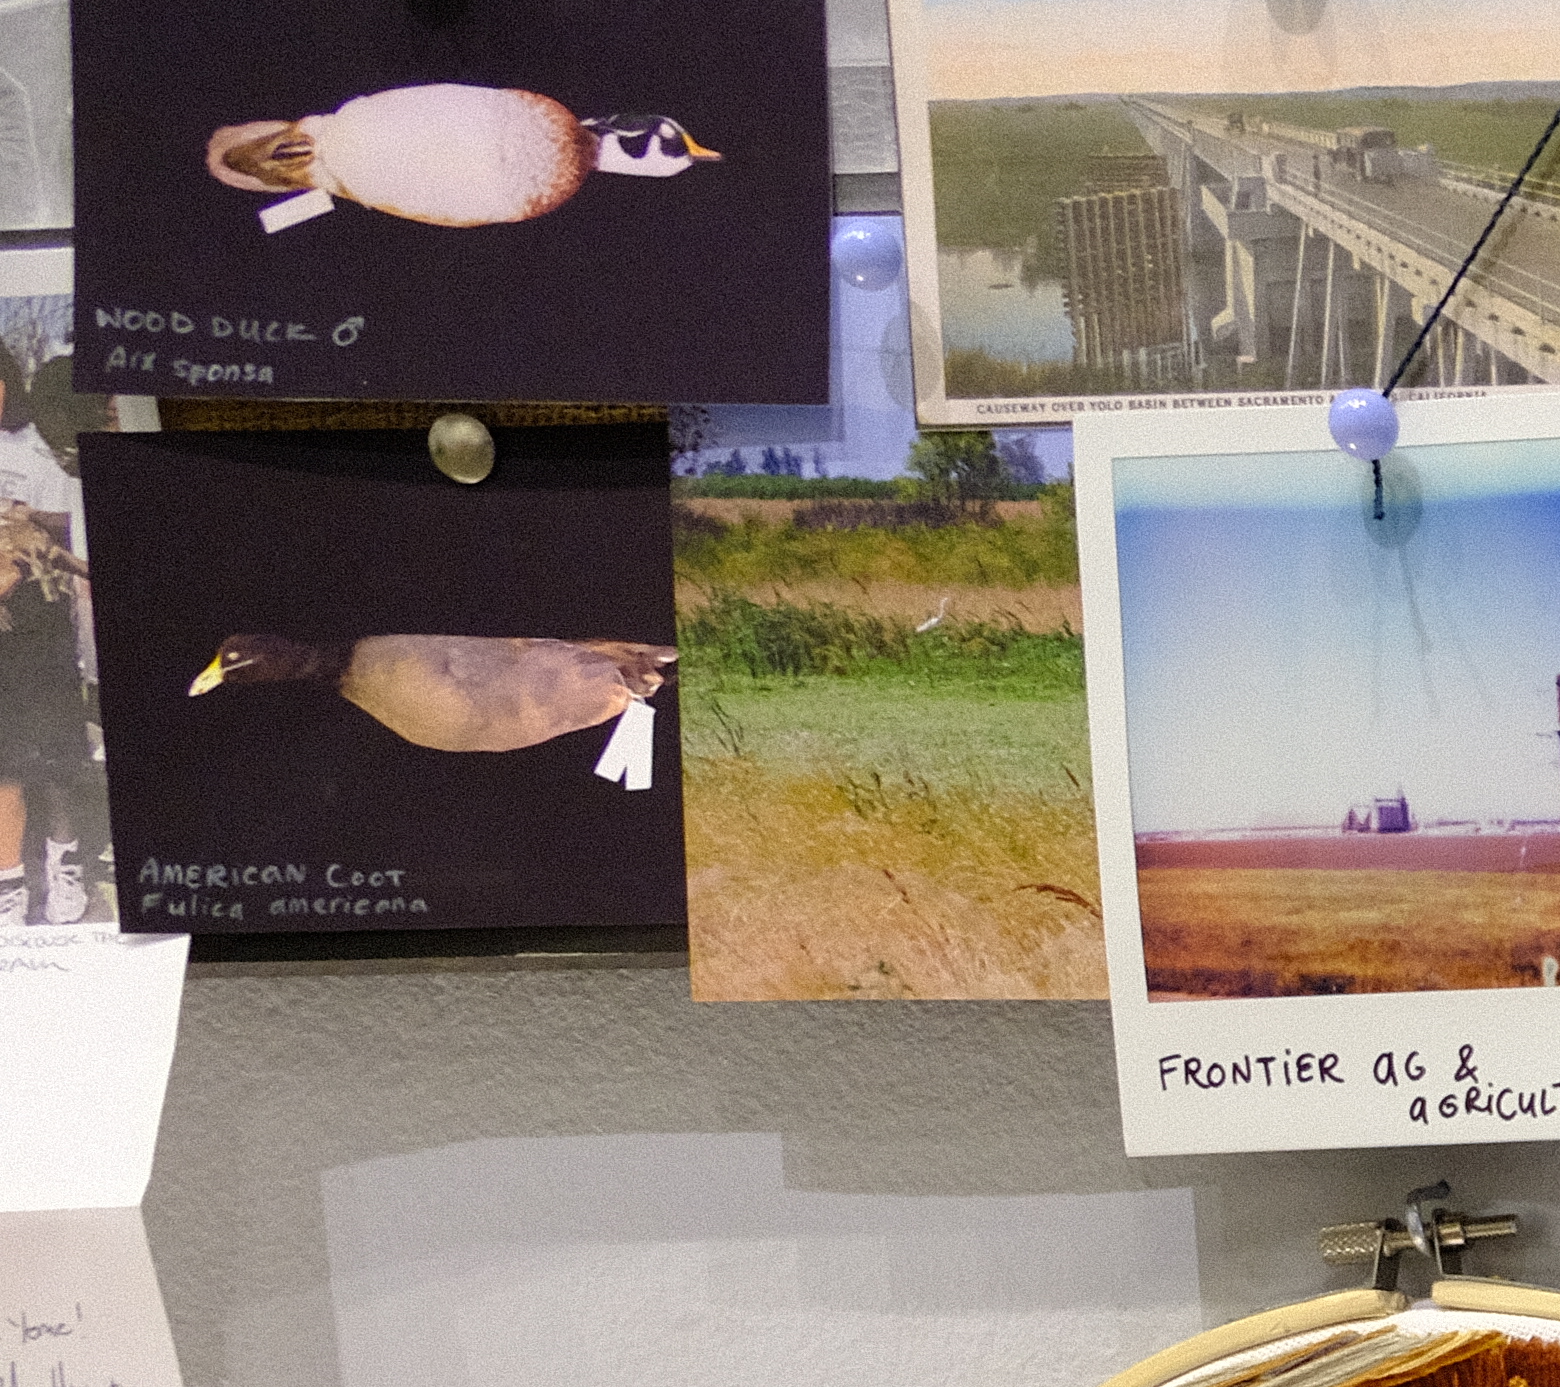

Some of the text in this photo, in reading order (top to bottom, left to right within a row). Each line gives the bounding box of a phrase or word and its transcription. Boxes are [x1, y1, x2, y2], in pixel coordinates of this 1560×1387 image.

[95, 306, 316, 341] WOOD DUCK
[977, 404, 1046, 414] CAUSEWAY
[1051, 402, 1085, 412] OVER
[1088, 401, 1123, 411] YOLO
[1128, 400, 1167, 410] BASIN
[1172, 398, 1233, 409] BETWEEN
[138, 857, 306, 888] AMERICAN
[1454, 1044, 1478, 1083] &
